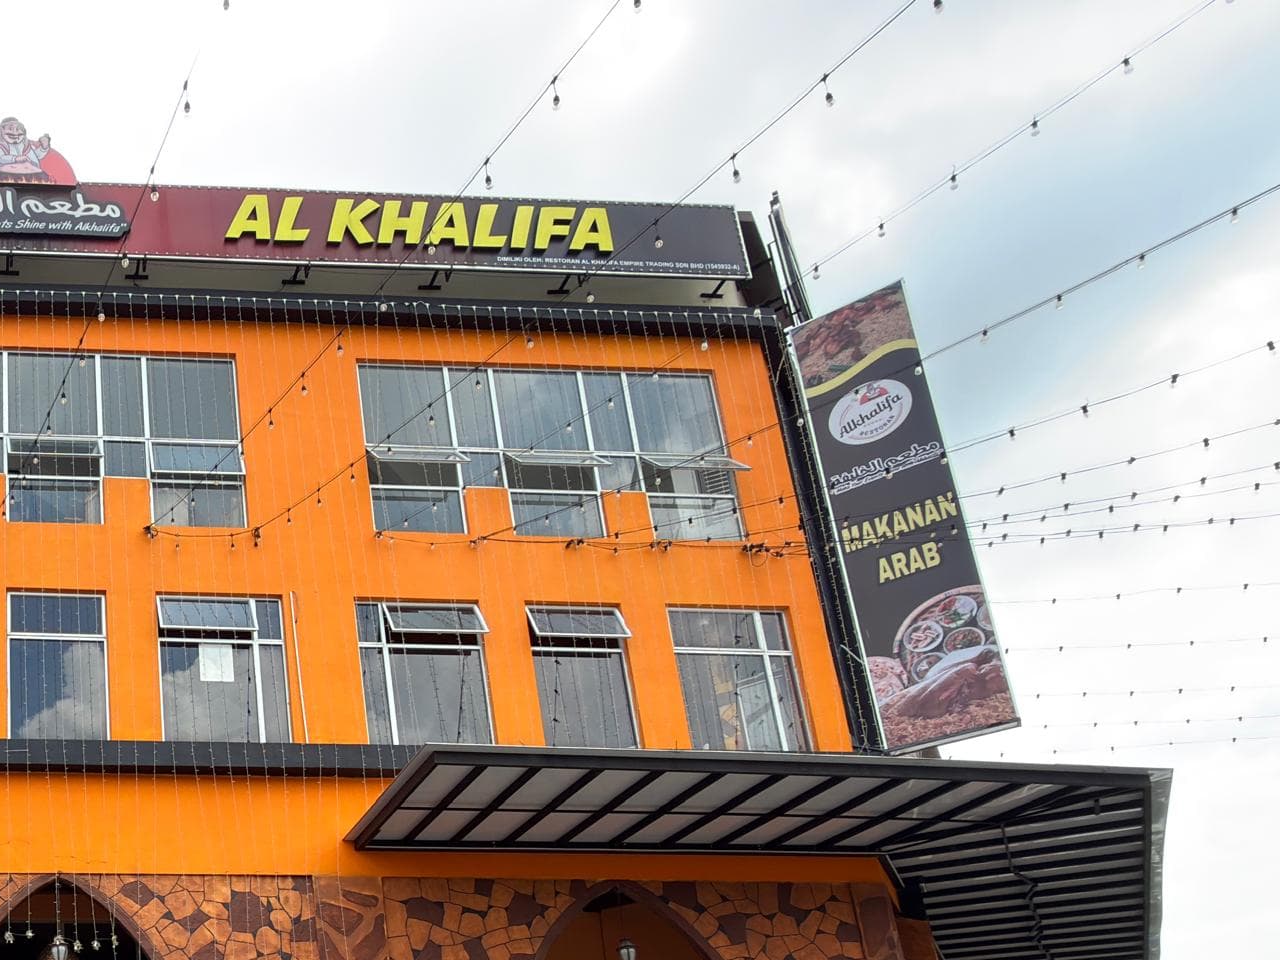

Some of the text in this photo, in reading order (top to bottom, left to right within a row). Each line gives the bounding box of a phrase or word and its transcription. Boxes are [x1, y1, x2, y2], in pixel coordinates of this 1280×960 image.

[15, 219, 46, 230] Shine
[49, 220, 72, 230] with
[21, 193, 121, 217] مطعم
[223, 194, 614, 252] AL KHALIFA
[840, 394, 903, 438] Alkhalifa
[841, 491, 957, 554] MAKANAN
[879, 541, 941, 584] ARAB
